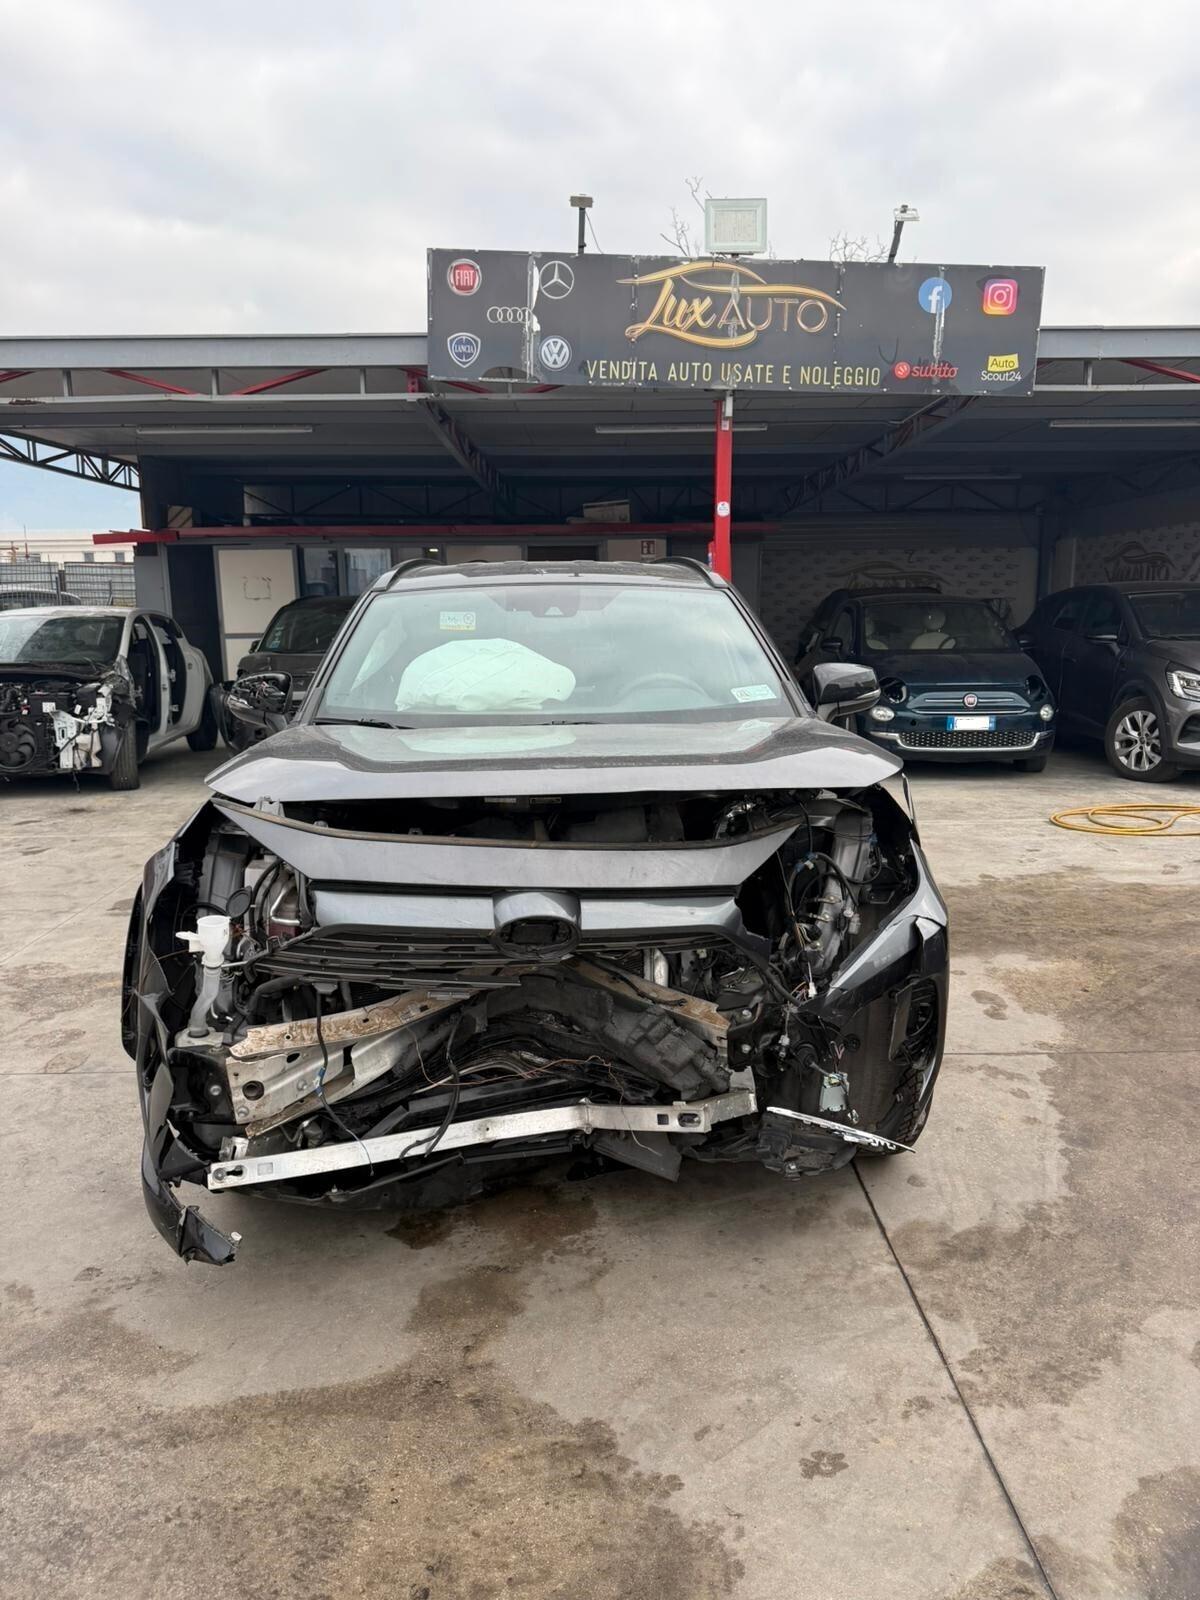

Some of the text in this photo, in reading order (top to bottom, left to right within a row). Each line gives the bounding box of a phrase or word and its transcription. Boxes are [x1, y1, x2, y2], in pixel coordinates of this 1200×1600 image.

[455, 269, 475, 287] FIAT
[911, 363, 958, 378] subito
[990, 358, 1015, 369] Auto
[587, 359, 881, 386] VENDITA AUTO USATE E NOLEGGIO
[980, 370, 1022, 382] Scout24
